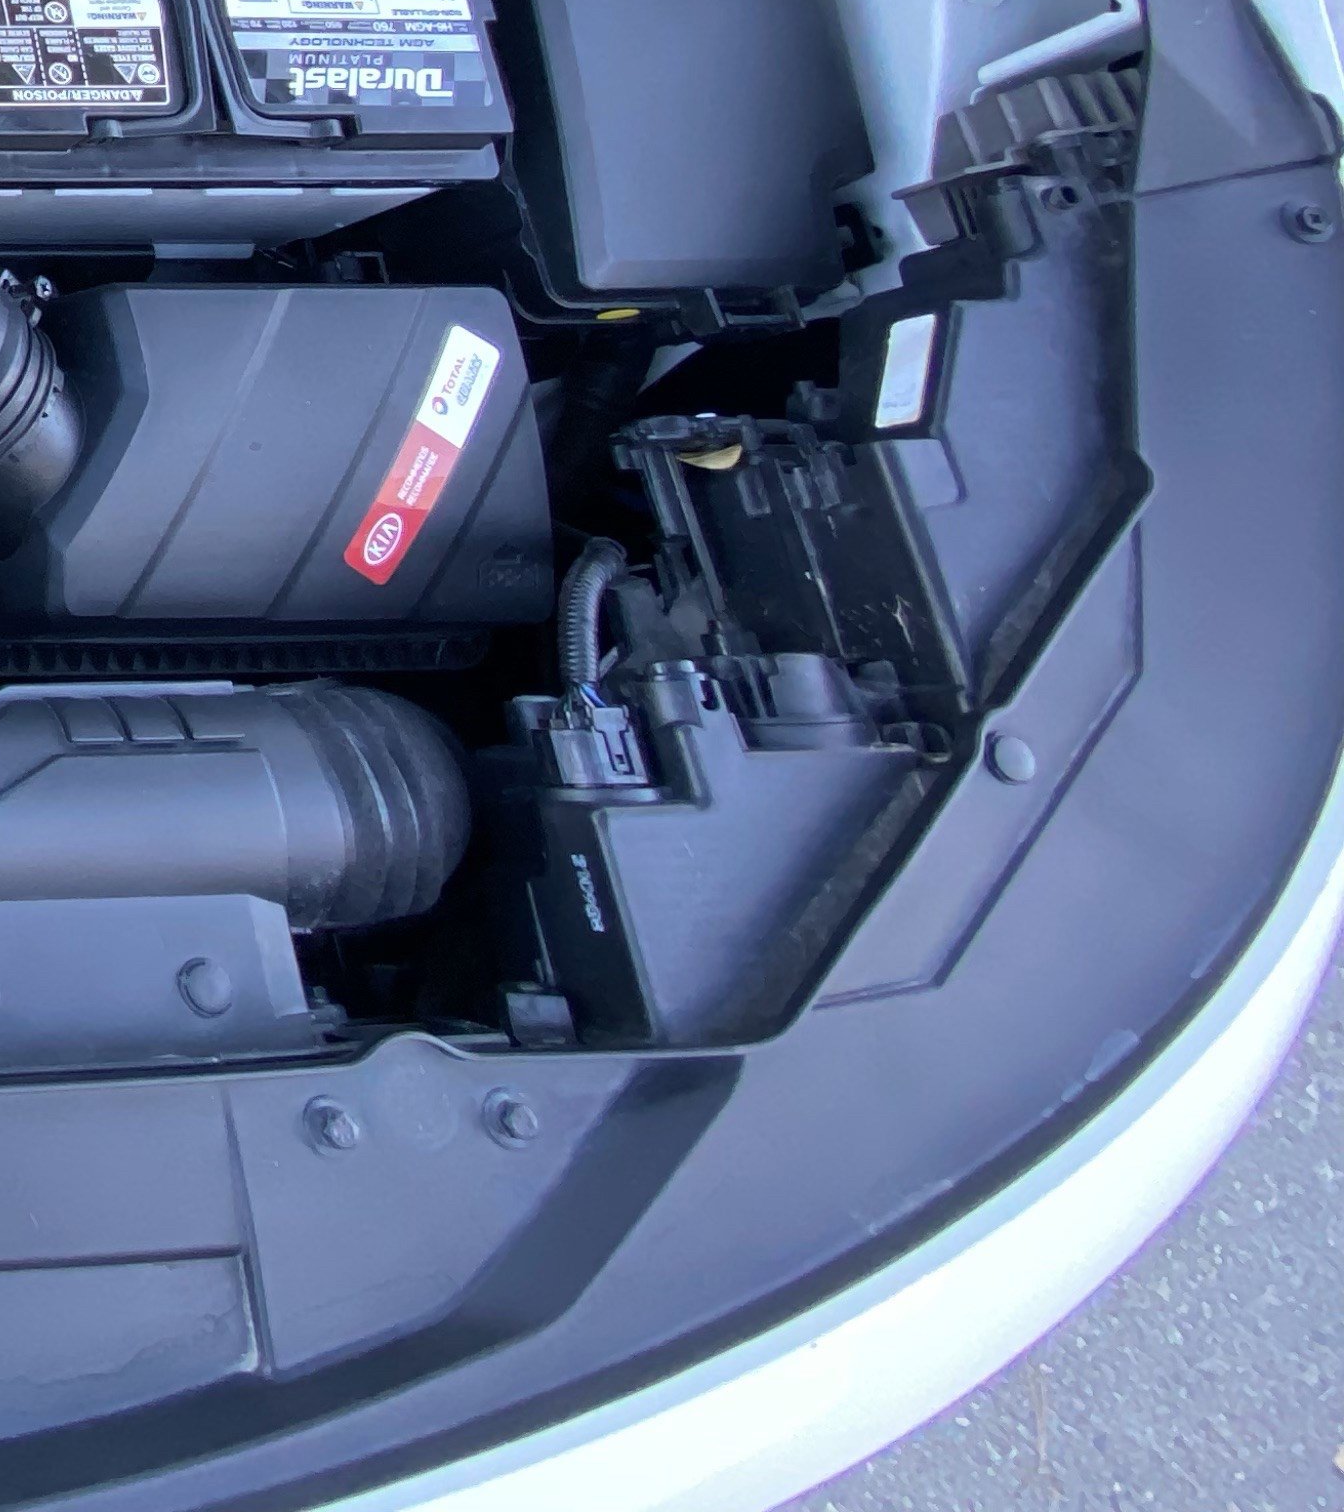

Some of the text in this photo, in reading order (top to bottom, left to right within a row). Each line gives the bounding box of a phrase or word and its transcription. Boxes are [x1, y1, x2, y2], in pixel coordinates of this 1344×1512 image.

[373, 21, 396, 32] 760
[288, 38, 434, 47] AGM TECHNOLOGY
[288, 53, 383, 65] PLATINUM
[288, 67, 453, 97] Duralast
[12, 89, 131, 100] DANGER/POISON
[441, 356, 466, 396] TOTAL
[368, 522, 399, 559] KIA
